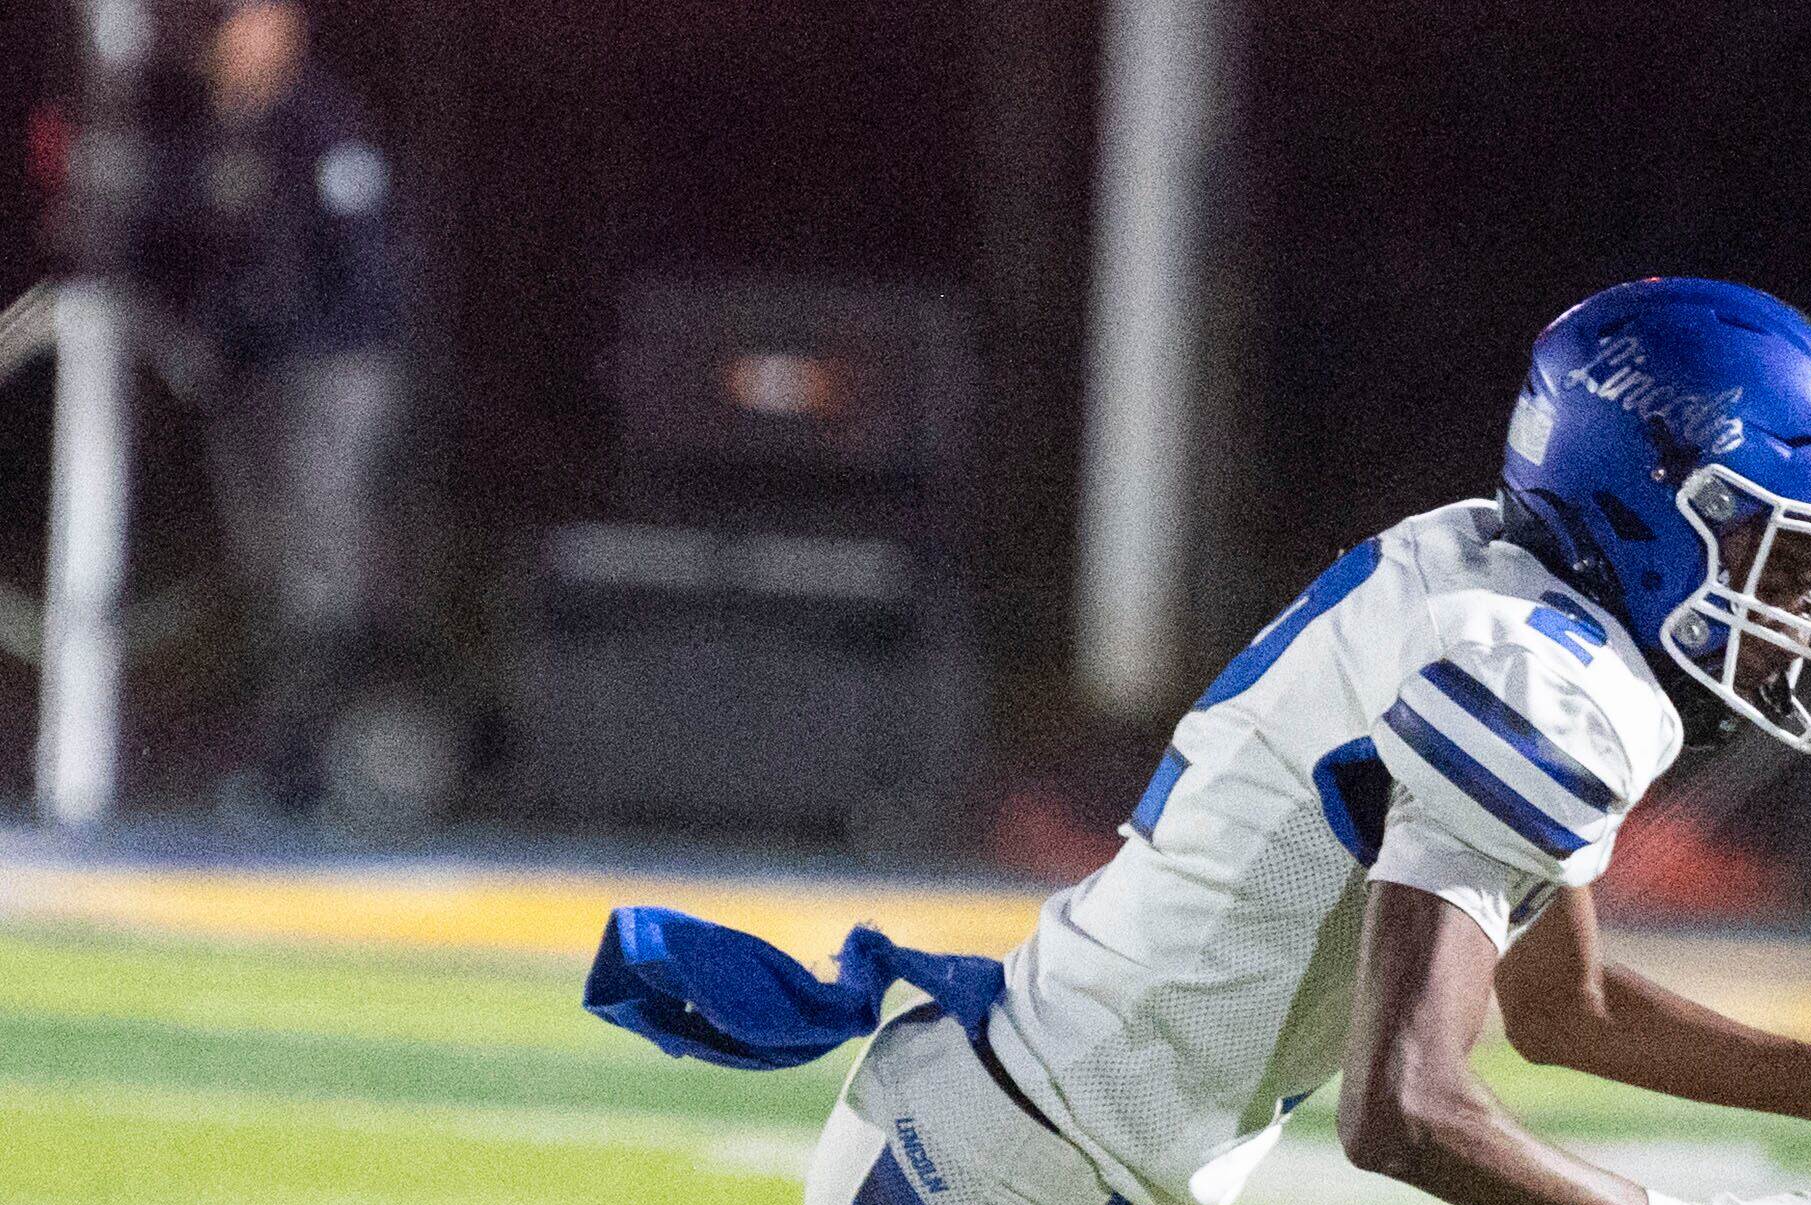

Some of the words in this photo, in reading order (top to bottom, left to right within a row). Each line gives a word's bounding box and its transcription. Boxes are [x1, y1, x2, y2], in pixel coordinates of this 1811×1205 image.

[1564, 336, 1746, 455] Lincoln
[1526, 592, 1609, 666] 2
[895, 1117, 950, 1194] LINCOLN
